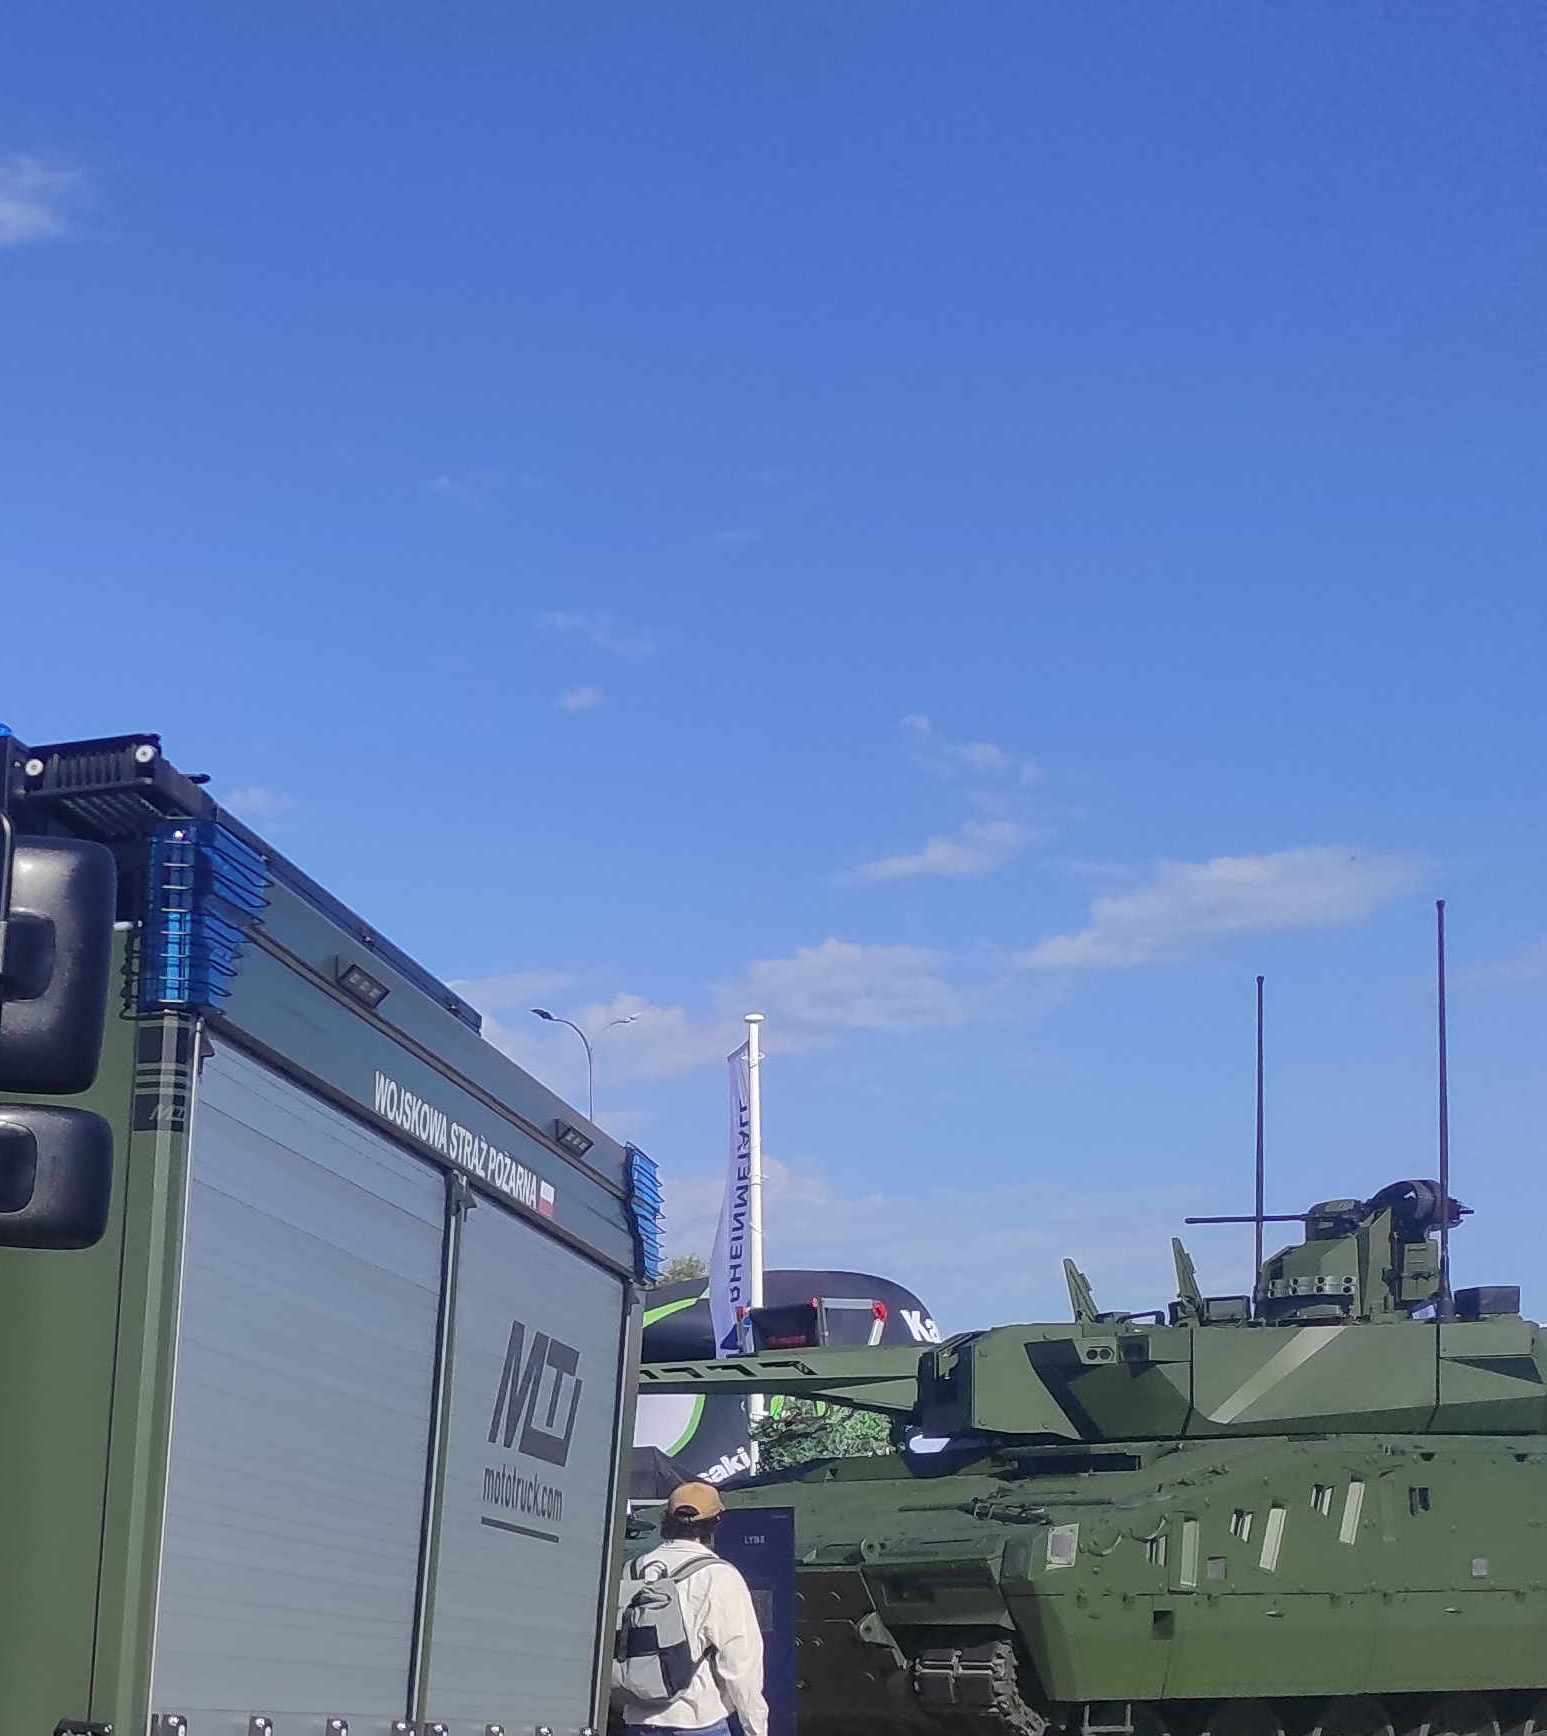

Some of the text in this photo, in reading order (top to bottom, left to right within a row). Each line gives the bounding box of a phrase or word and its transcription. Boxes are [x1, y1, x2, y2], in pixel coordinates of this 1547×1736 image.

[375, 1070, 537, 1210] WOJSKOWA STRAŻ POŻARNA
[482, 1463, 563, 1521] mototruck.com
